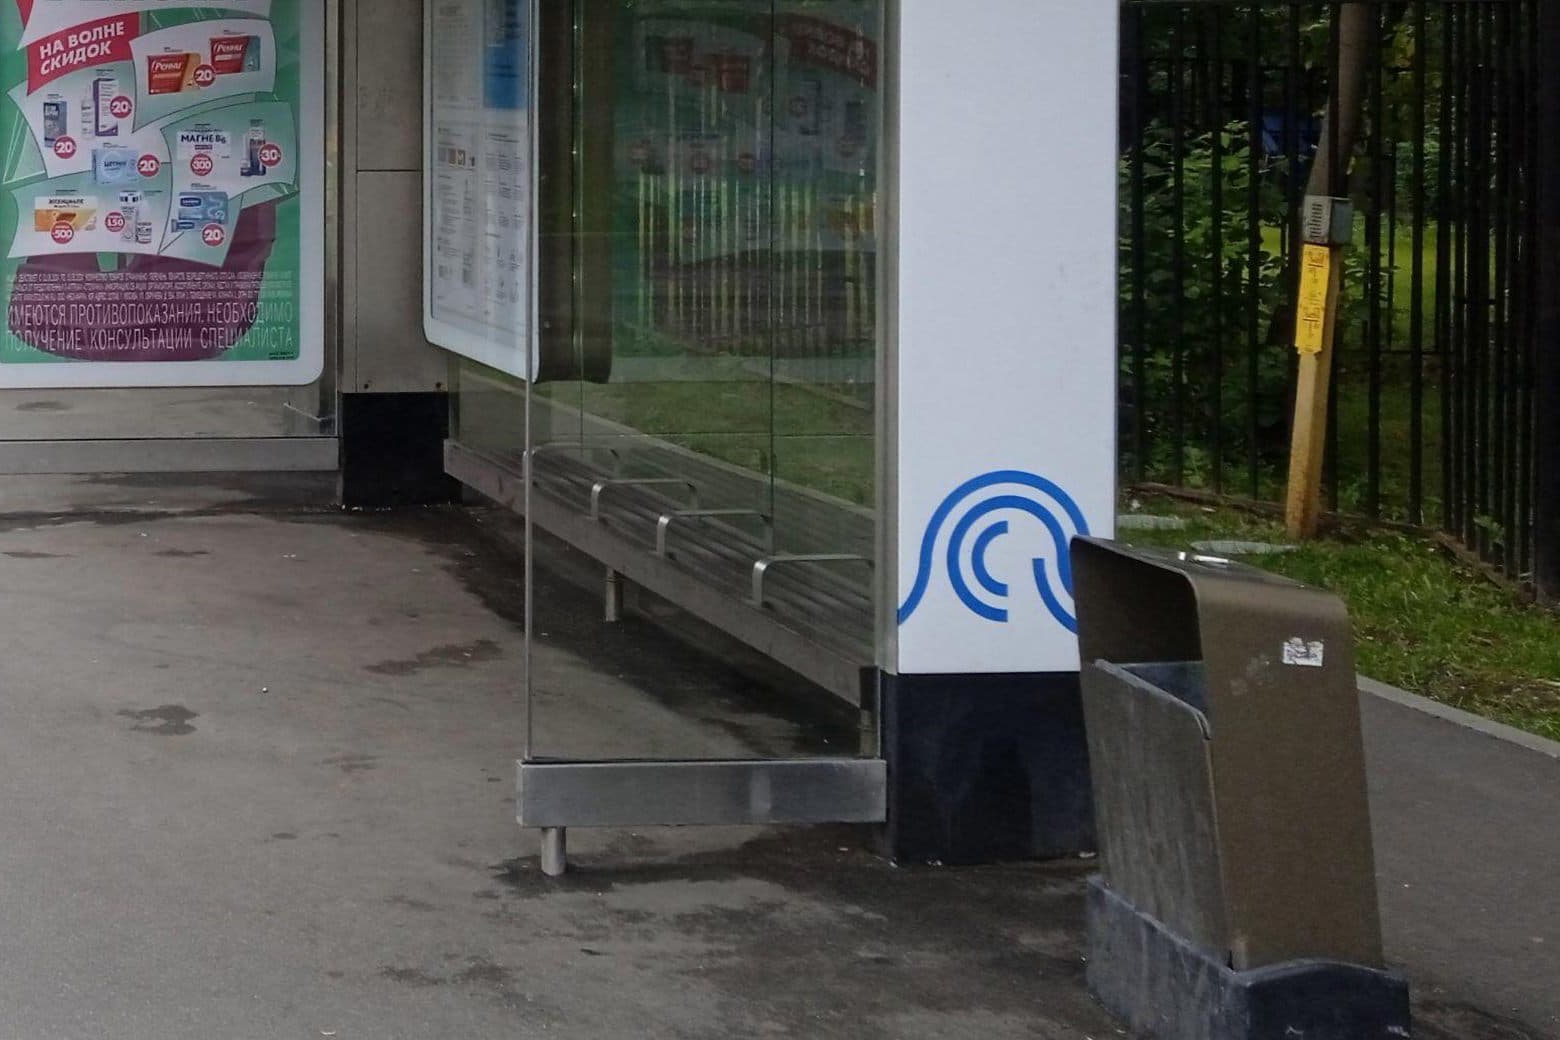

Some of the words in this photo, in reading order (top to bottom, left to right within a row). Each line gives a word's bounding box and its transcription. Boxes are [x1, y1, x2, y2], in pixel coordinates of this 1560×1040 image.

[39, 39, 66, 59] НА
[67, 21, 125, 50] ВОЛНЕ
[39, 40, 113, 76] СКИДОК
[6, 303, 66, 326] ИМЕЮТСЯ
[207, 301, 293, 324] НЕОБХОДИМО
[6, 328, 82, 352] ПОЛУЧЕНИЕ
[90, 327, 193, 352] КОНСУЛЬТАЦИИ
[200, 326, 293, 350] СПЕЦИАЛИСТА
